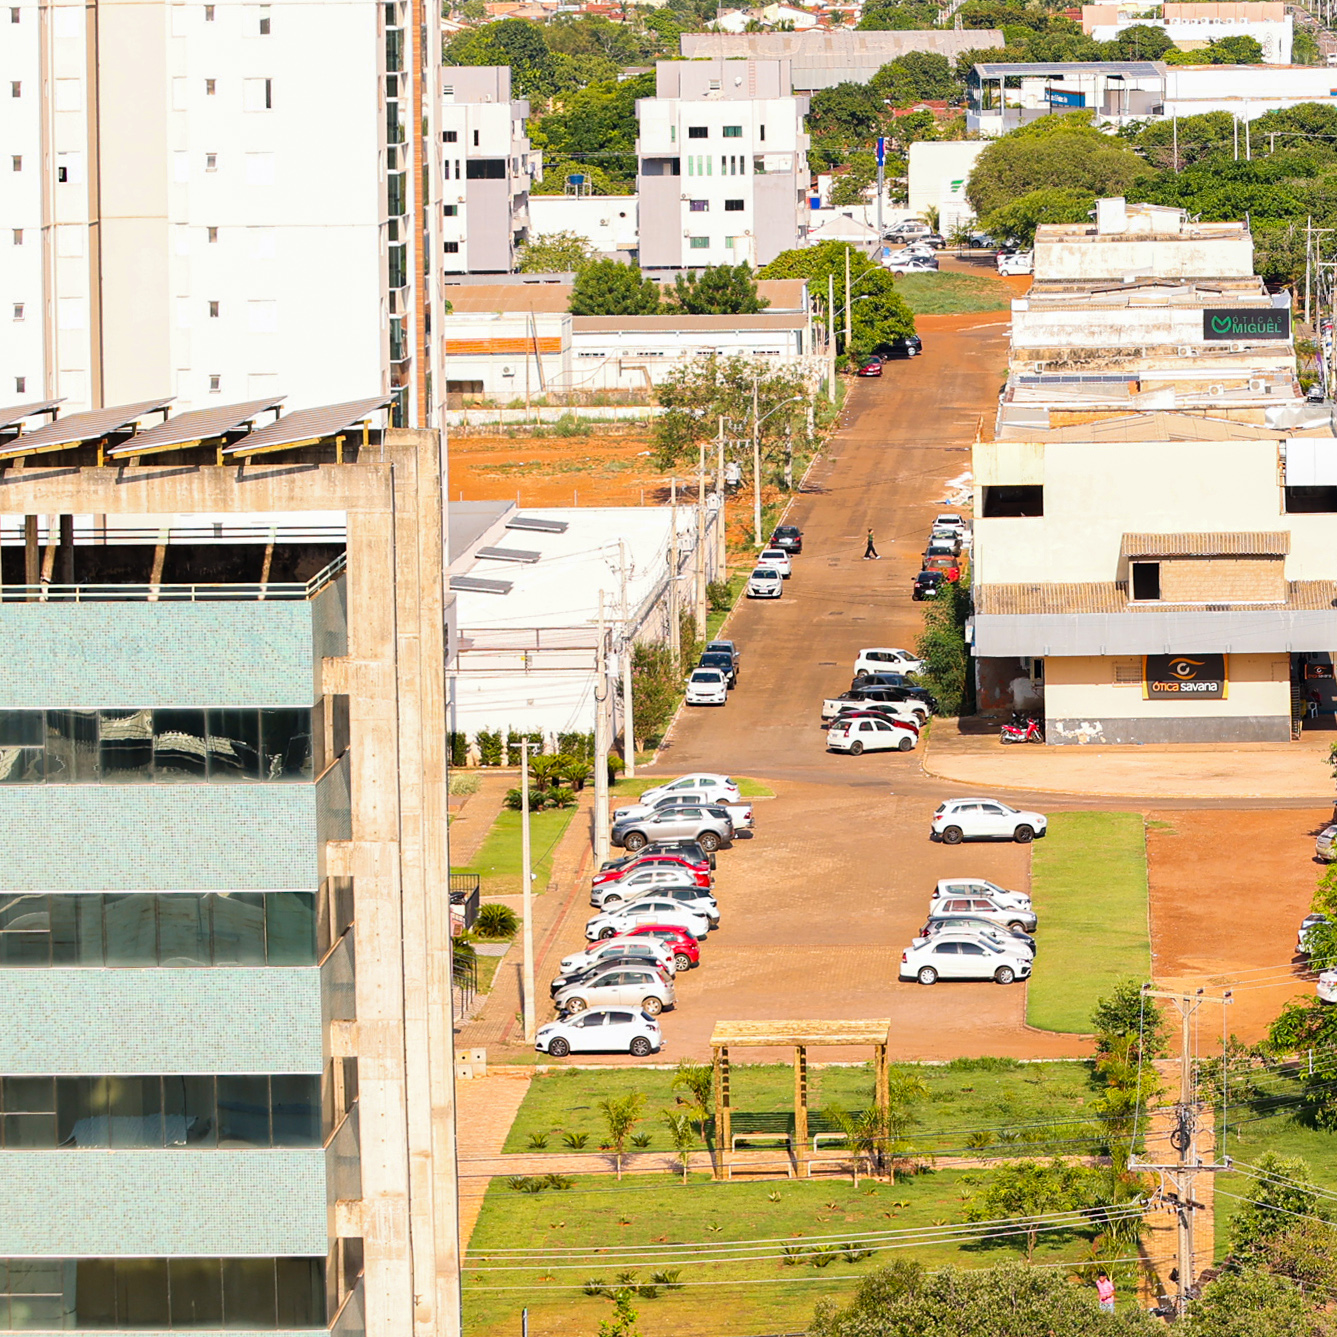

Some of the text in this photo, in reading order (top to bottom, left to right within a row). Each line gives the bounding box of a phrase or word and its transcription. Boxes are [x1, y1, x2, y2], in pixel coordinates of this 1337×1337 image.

[1232, 315, 1282, 324] ÓTICAS
[1232, 323, 1282, 334] MIGUEL
[1180, 682, 1218, 692] savana
